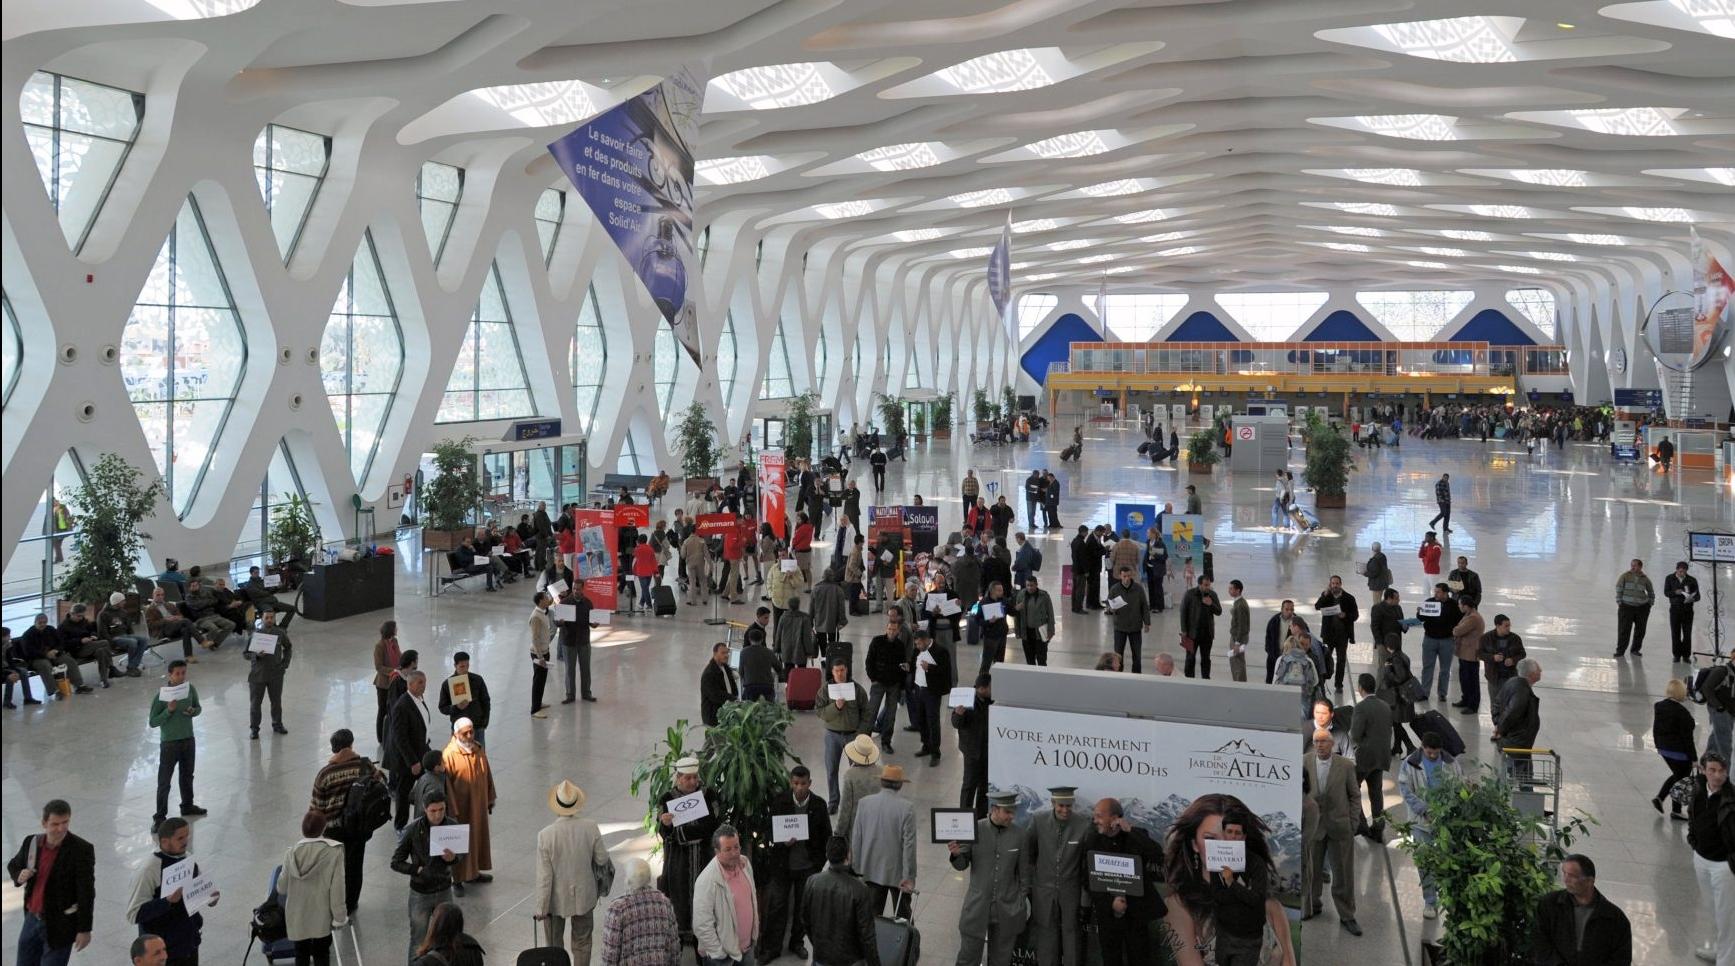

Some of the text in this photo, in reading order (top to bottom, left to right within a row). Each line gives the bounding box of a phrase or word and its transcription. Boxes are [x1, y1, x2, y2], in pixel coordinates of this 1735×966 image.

[588, 124, 644, 160] Le savoir faire
[584, 146, 642, 178] et des produits
[576, 163, 641, 196] en fer dans votre
[614, 197, 641, 214] espace
[996, 727, 1151, 753] VOTRE APPARTEMENT
[1033, 745, 1047, 766] À
[1052, 749, 1133, 774] 100.000
[1188, 758, 1291, 781] JARDINS ATLAS
